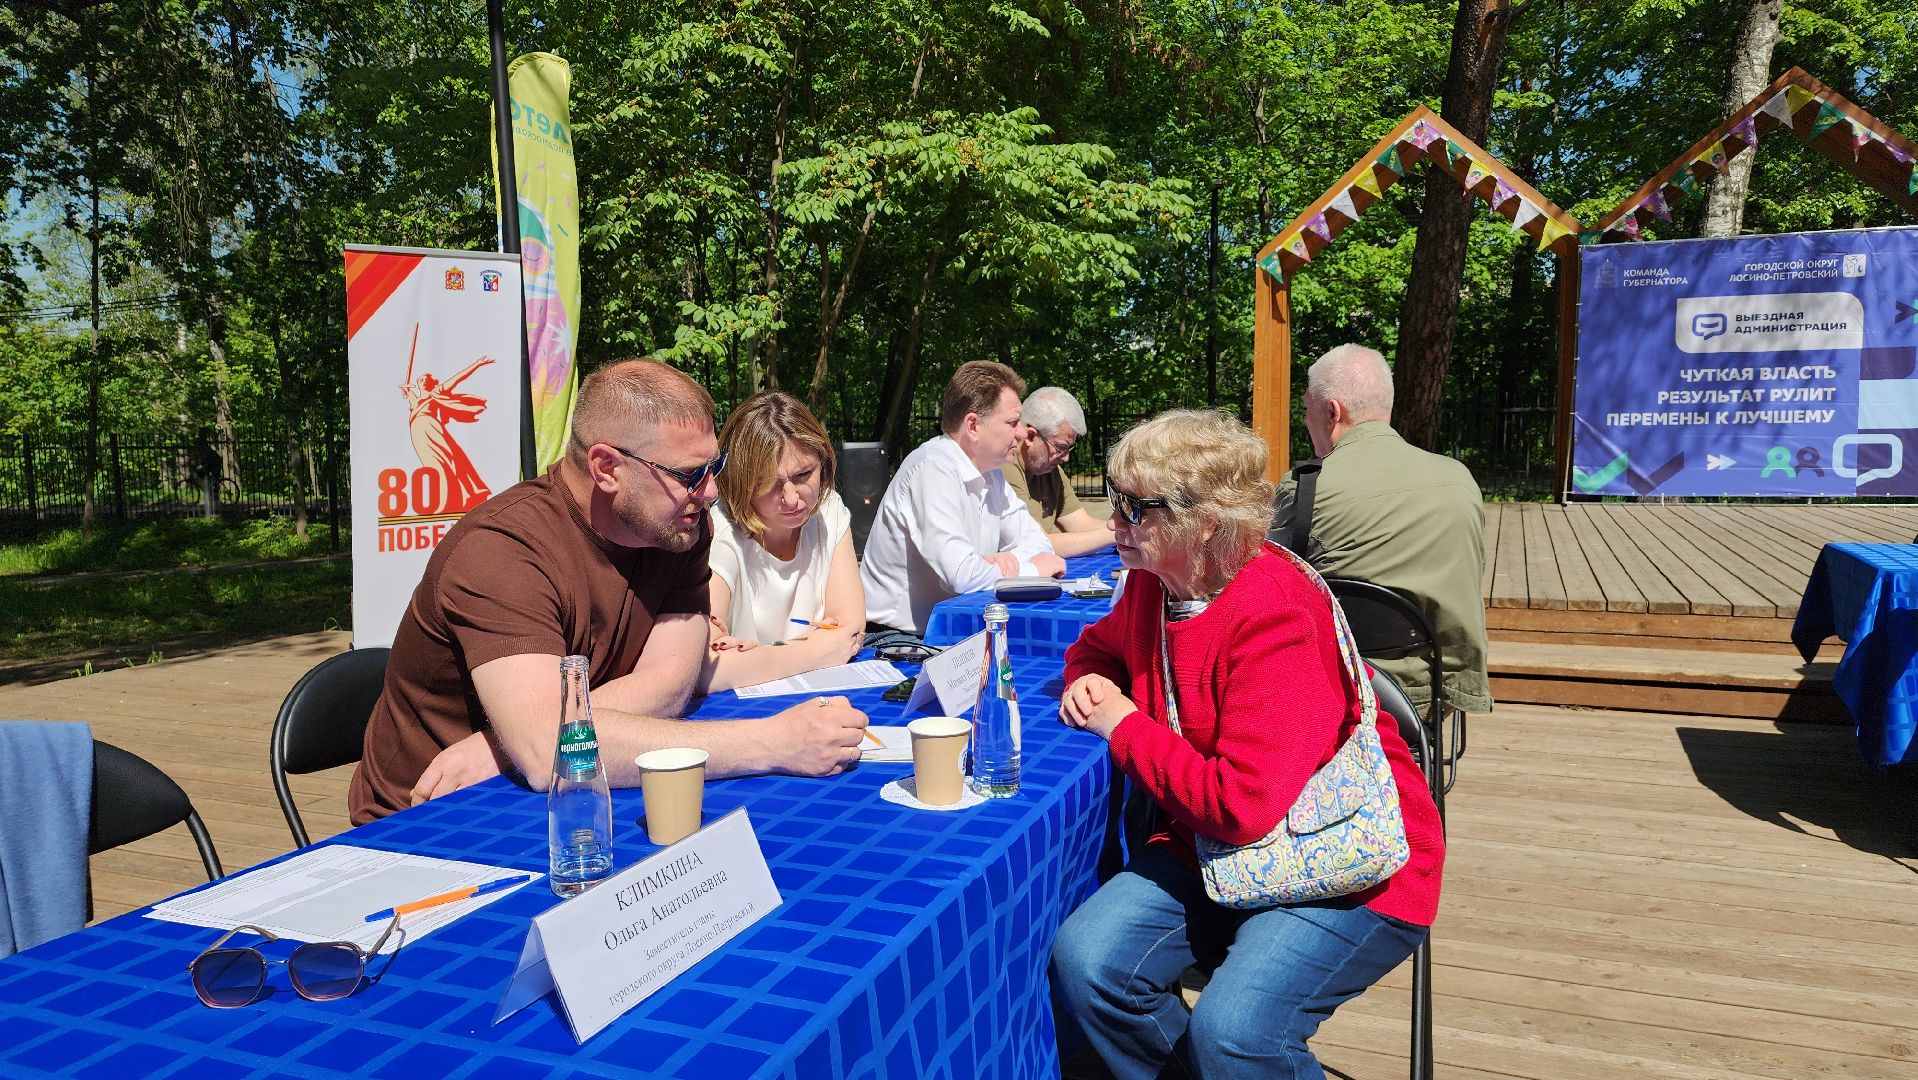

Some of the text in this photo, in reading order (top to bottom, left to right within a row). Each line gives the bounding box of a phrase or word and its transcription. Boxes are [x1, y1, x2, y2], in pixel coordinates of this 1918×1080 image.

[1624, 268, 1670, 277] КОМАНДА
[1744, 259, 1839, 271] ГОРОДСКОЙ ОКРУГ
[1624, 277, 1688, 287] ГУБЕРНАТОРА
[1729, 268, 1839, 282] ЛОСИНО-ПЕТРОВСКИЙ
[1735, 311, 1804, 322] ВЫЕЗДНАЯ
[1734, 322, 1847, 334] АДМИНИСТРАЦИЯ
[1680, 365, 1836, 383] ЧУТКАЯ ВЛАСТЬ
[1657, 387, 1836, 405] РЕЗУЛЬТАТ РУЛИТ
[1606, 410, 1835, 426] ПЕРЕМЕНЫ К ЛУЧШЕМУ
[377, 466, 441, 516] 80
[378, 524, 455, 552] ПОБЕ
[615, 850, 703, 911] КЛИМКИНА
[604, 869, 728, 951] Ольга Анатольевна
[608, 969, 657, 1005] городского
